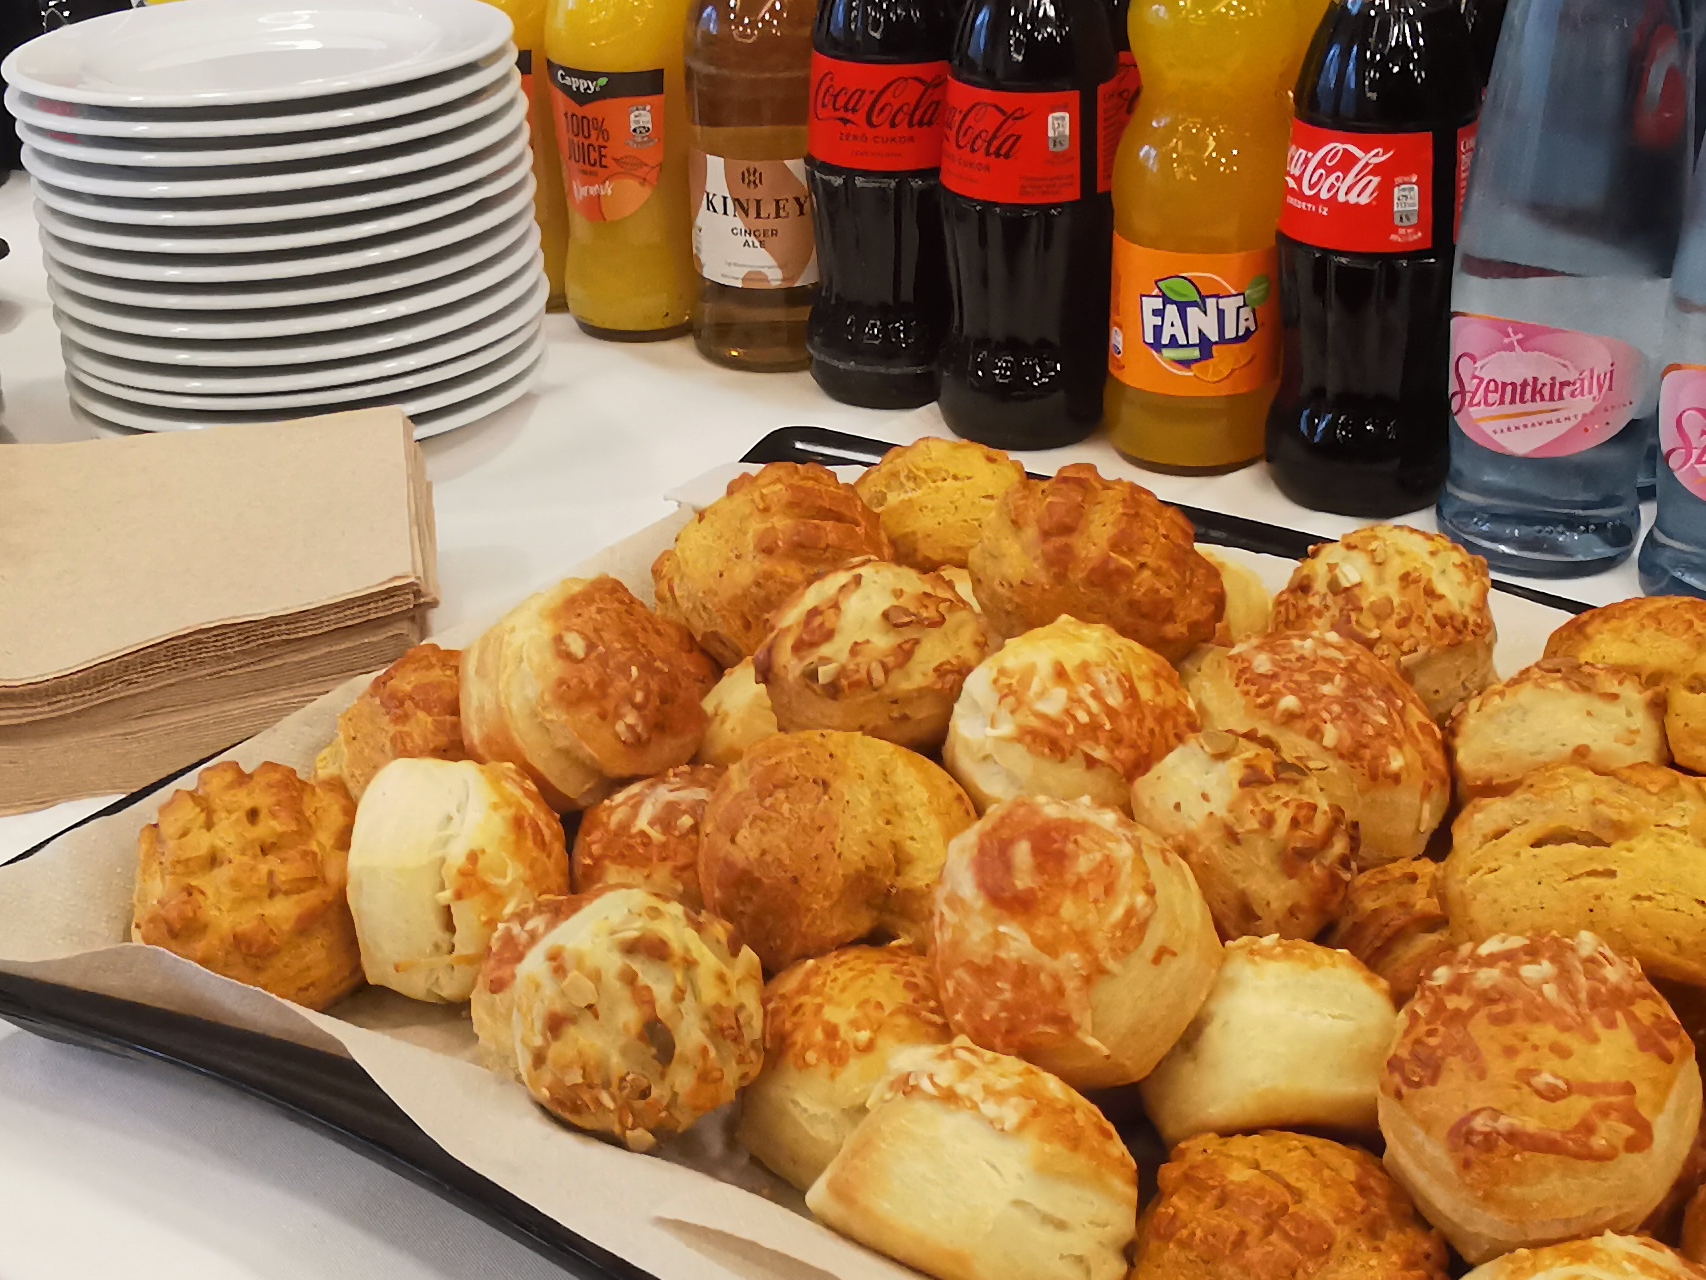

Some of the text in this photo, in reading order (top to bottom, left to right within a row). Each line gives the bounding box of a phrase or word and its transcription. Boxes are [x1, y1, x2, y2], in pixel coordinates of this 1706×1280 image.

[557, 69, 597, 94] Cappy
[815, 70, 948, 129] Coca-Cola
[564, 110, 610, 143] 100%
[568, 137, 609, 169] JUICE
[705, 190, 809, 220] KINLEY
[731, 226, 779, 238] GINGER
[742, 239, 766, 249] ALE
[1141, 294, 1257, 346] FANTA
[1449, 351, 1616, 417] Szentkirályi
